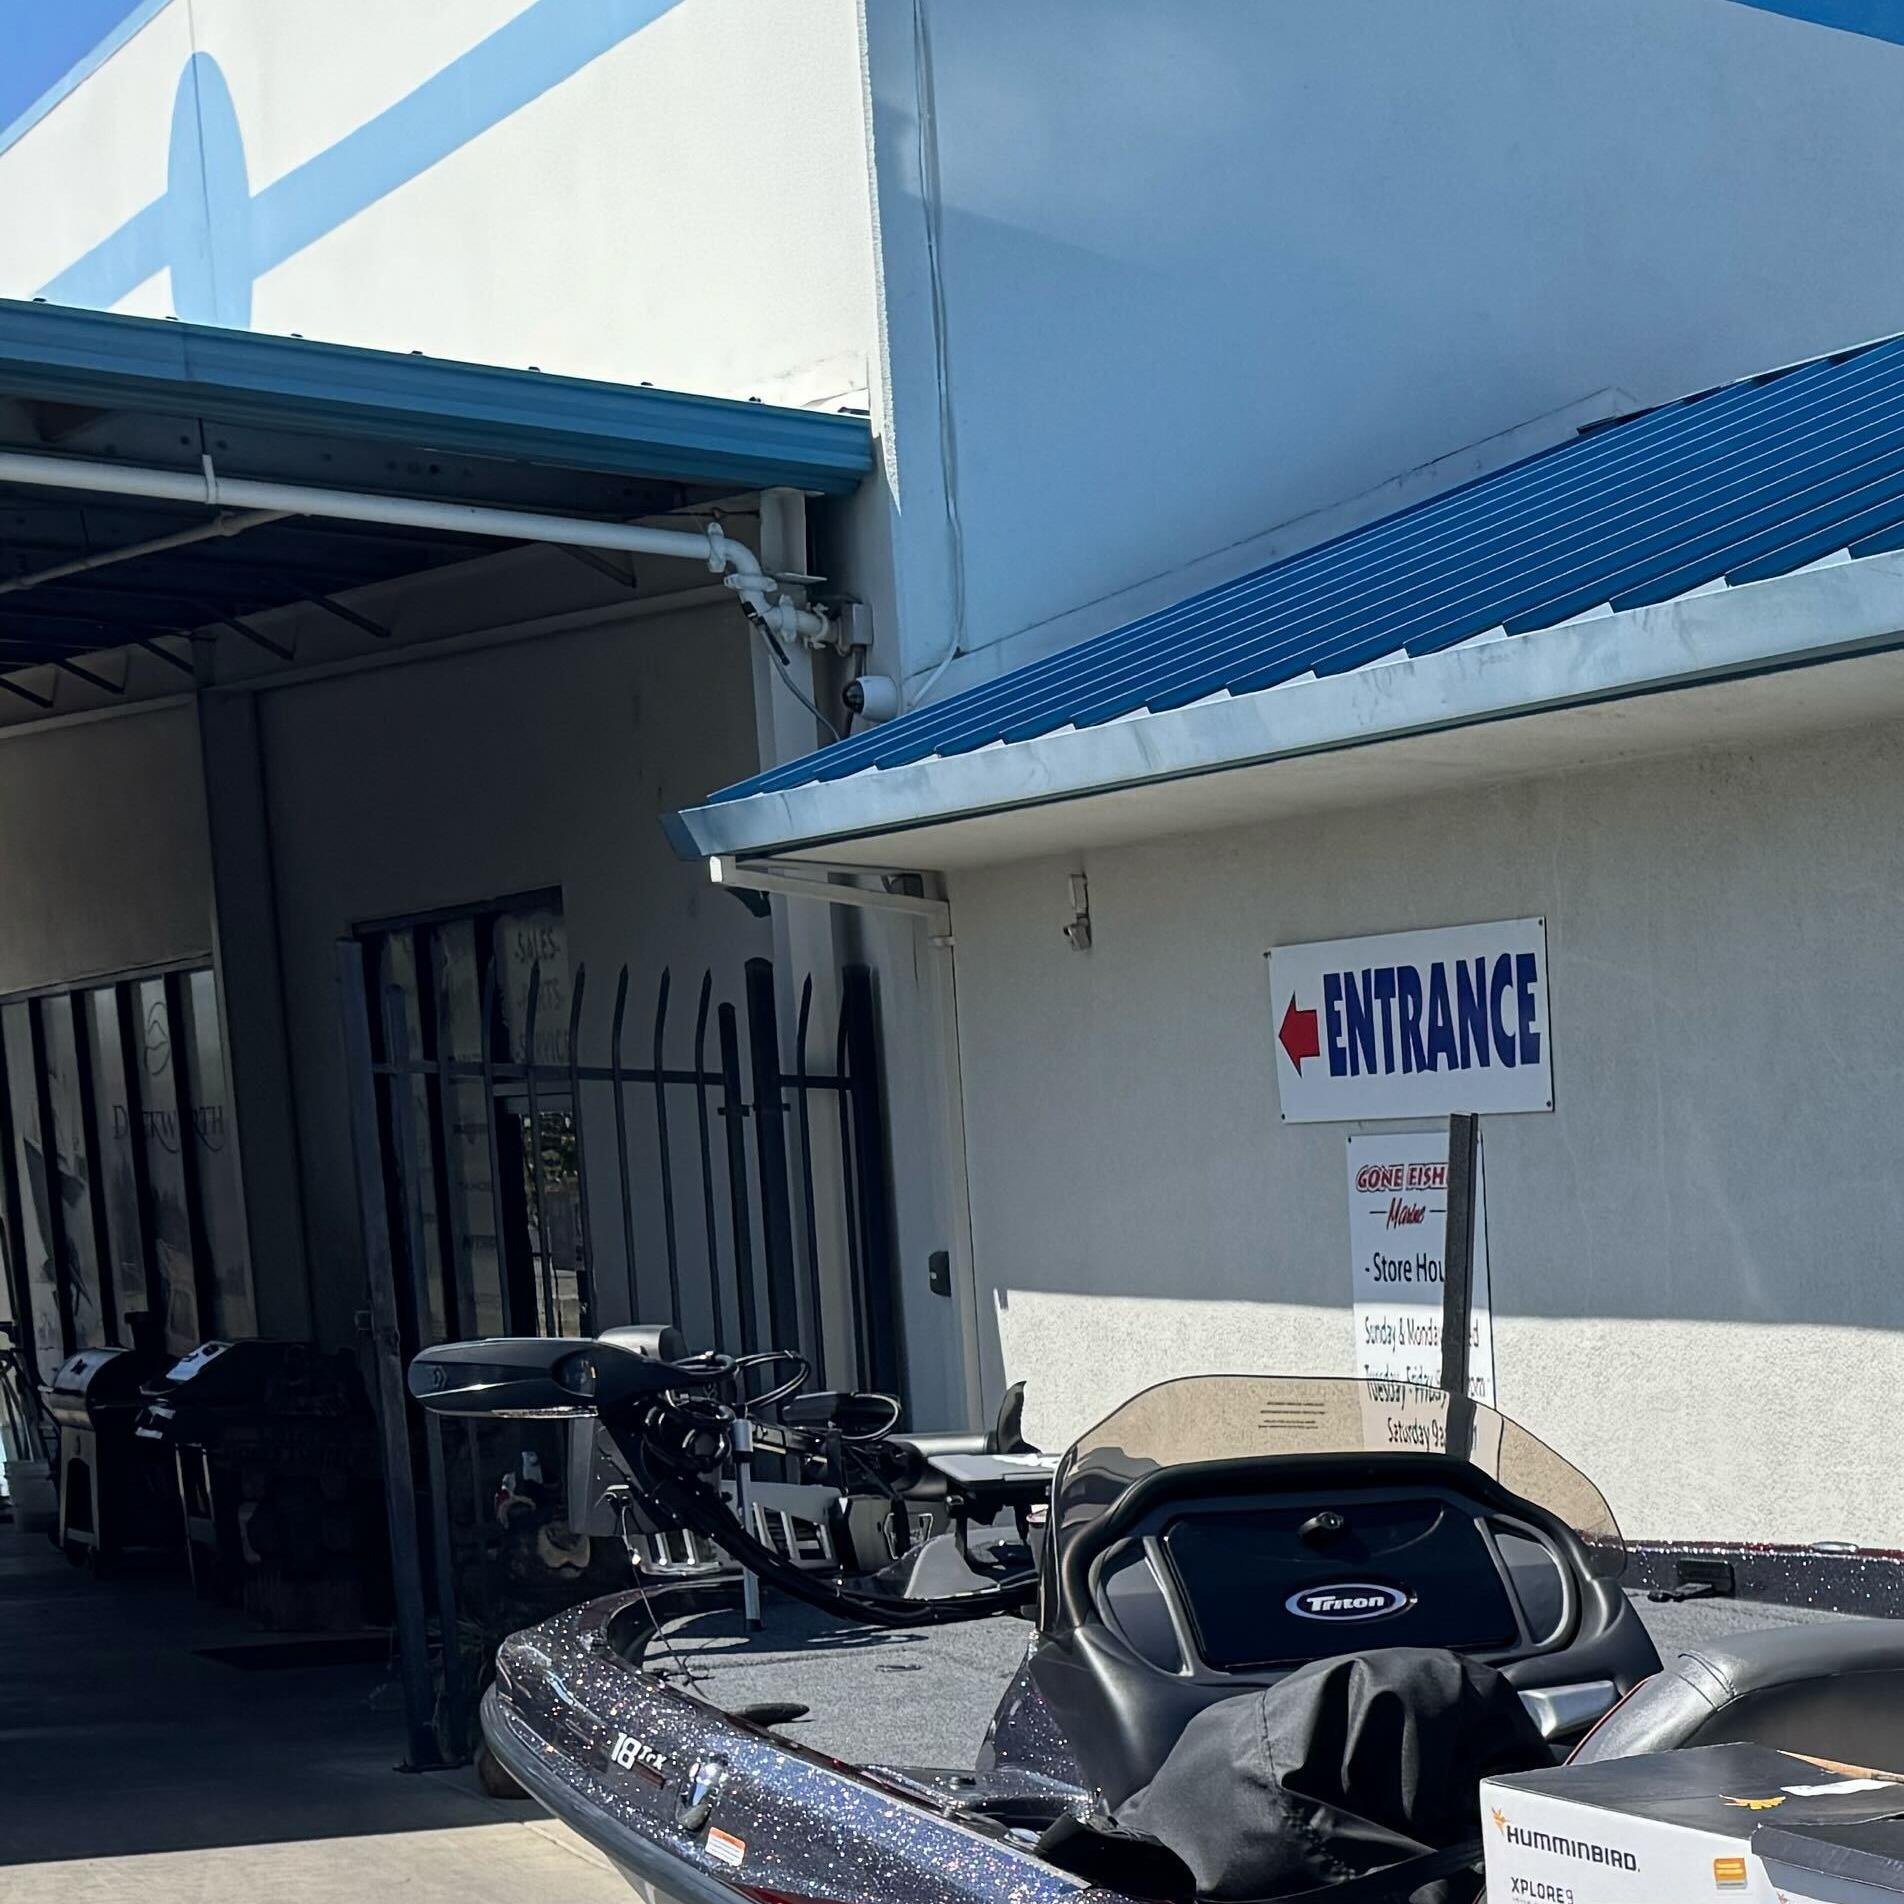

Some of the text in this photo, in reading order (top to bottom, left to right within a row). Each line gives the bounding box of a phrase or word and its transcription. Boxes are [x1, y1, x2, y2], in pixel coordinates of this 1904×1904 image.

[1323, 952, 1542, 1077] ENTRANCE
[1357, 1164, 1404, 1192] GONE
[1386, 1197, 1426, 1230] Marine
[1373, 1252, 1445, 1282] Store Hou
[1365, 1316, 1396, 1352] Sunday
[1406, 1317, 1441, 1348] Monda
[1388, 1417, 1431, 1452] Saturday
[1306, 1594, 1385, 1612] Triton
[611, 1732, 642, 1770] 18
[1507, 1825, 1638, 1871] HUMMINBIRD
